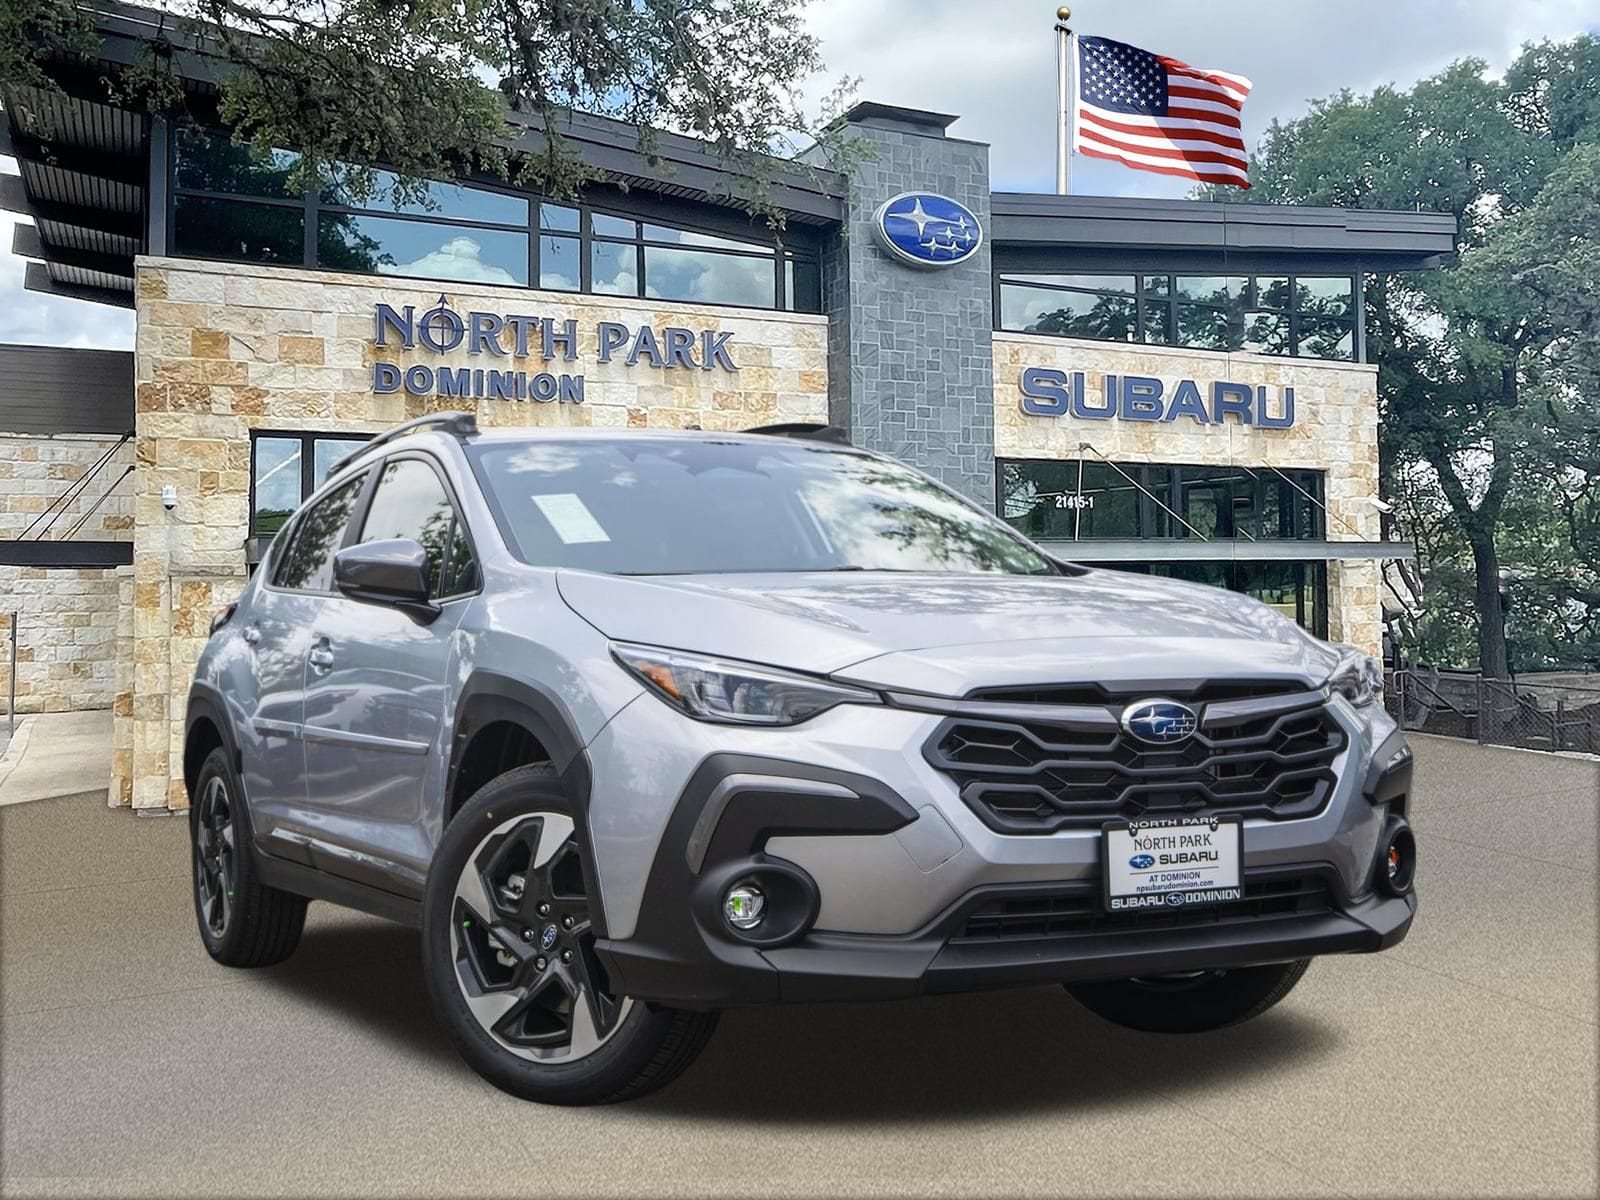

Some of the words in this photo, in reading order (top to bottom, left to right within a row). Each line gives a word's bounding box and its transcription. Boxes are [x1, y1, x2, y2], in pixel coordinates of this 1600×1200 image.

[374, 300, 580, 361] NORTH
[597, 320, 740, 373] PARK
[373, 361, 585, 404] DOMINION
[1020, 367, 1295, 430] SUBARU
[1129, 819, 1177, 829] NORTH
[1182, 816, 1219, 826] PARK
[1134, 835, 1176, 852] NORTH
[1180, 833, 1212, 848] PARK
[1159, 851, 1219, 865] SUBARU
[1136, 880, 1214, 893] npsubarudominion.com
[1149, 873, 1158, 883] AT
[1161, 871, 1201, 882] DOMINION
[1111, 895, 1165, 909] SUBARU
[1185, 889, 1241, 903] DOMINION
